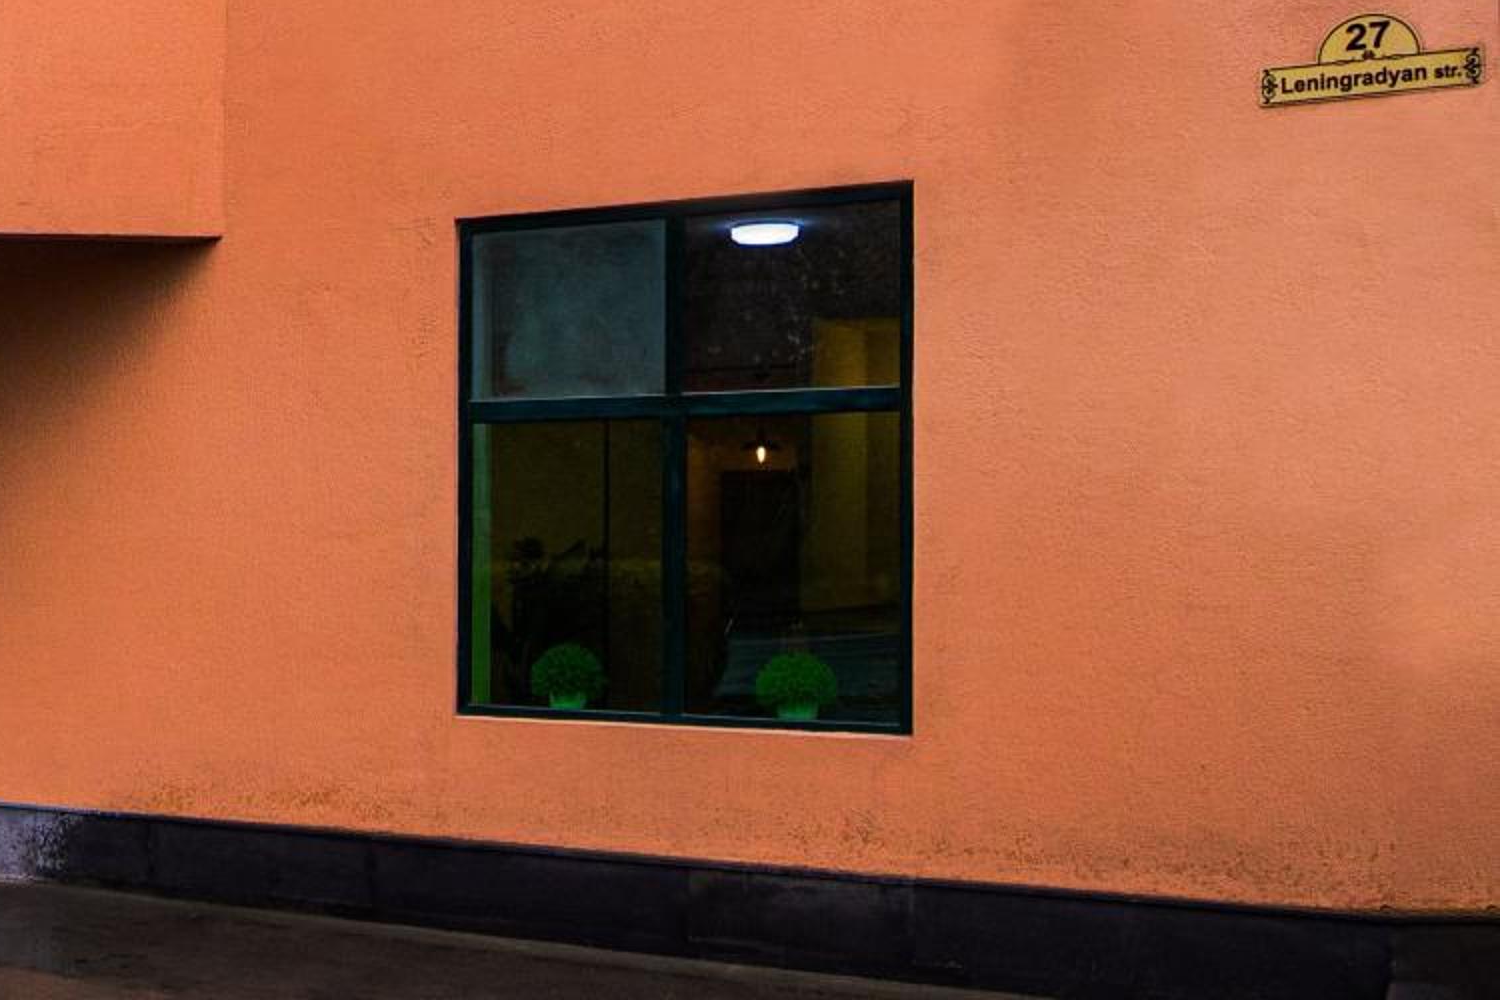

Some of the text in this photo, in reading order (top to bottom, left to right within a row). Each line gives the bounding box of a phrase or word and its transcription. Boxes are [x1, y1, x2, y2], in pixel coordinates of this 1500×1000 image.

[1345, 20, 1391, 51] 27
[1281, 64, 1463, 94] Leningradyan str.
